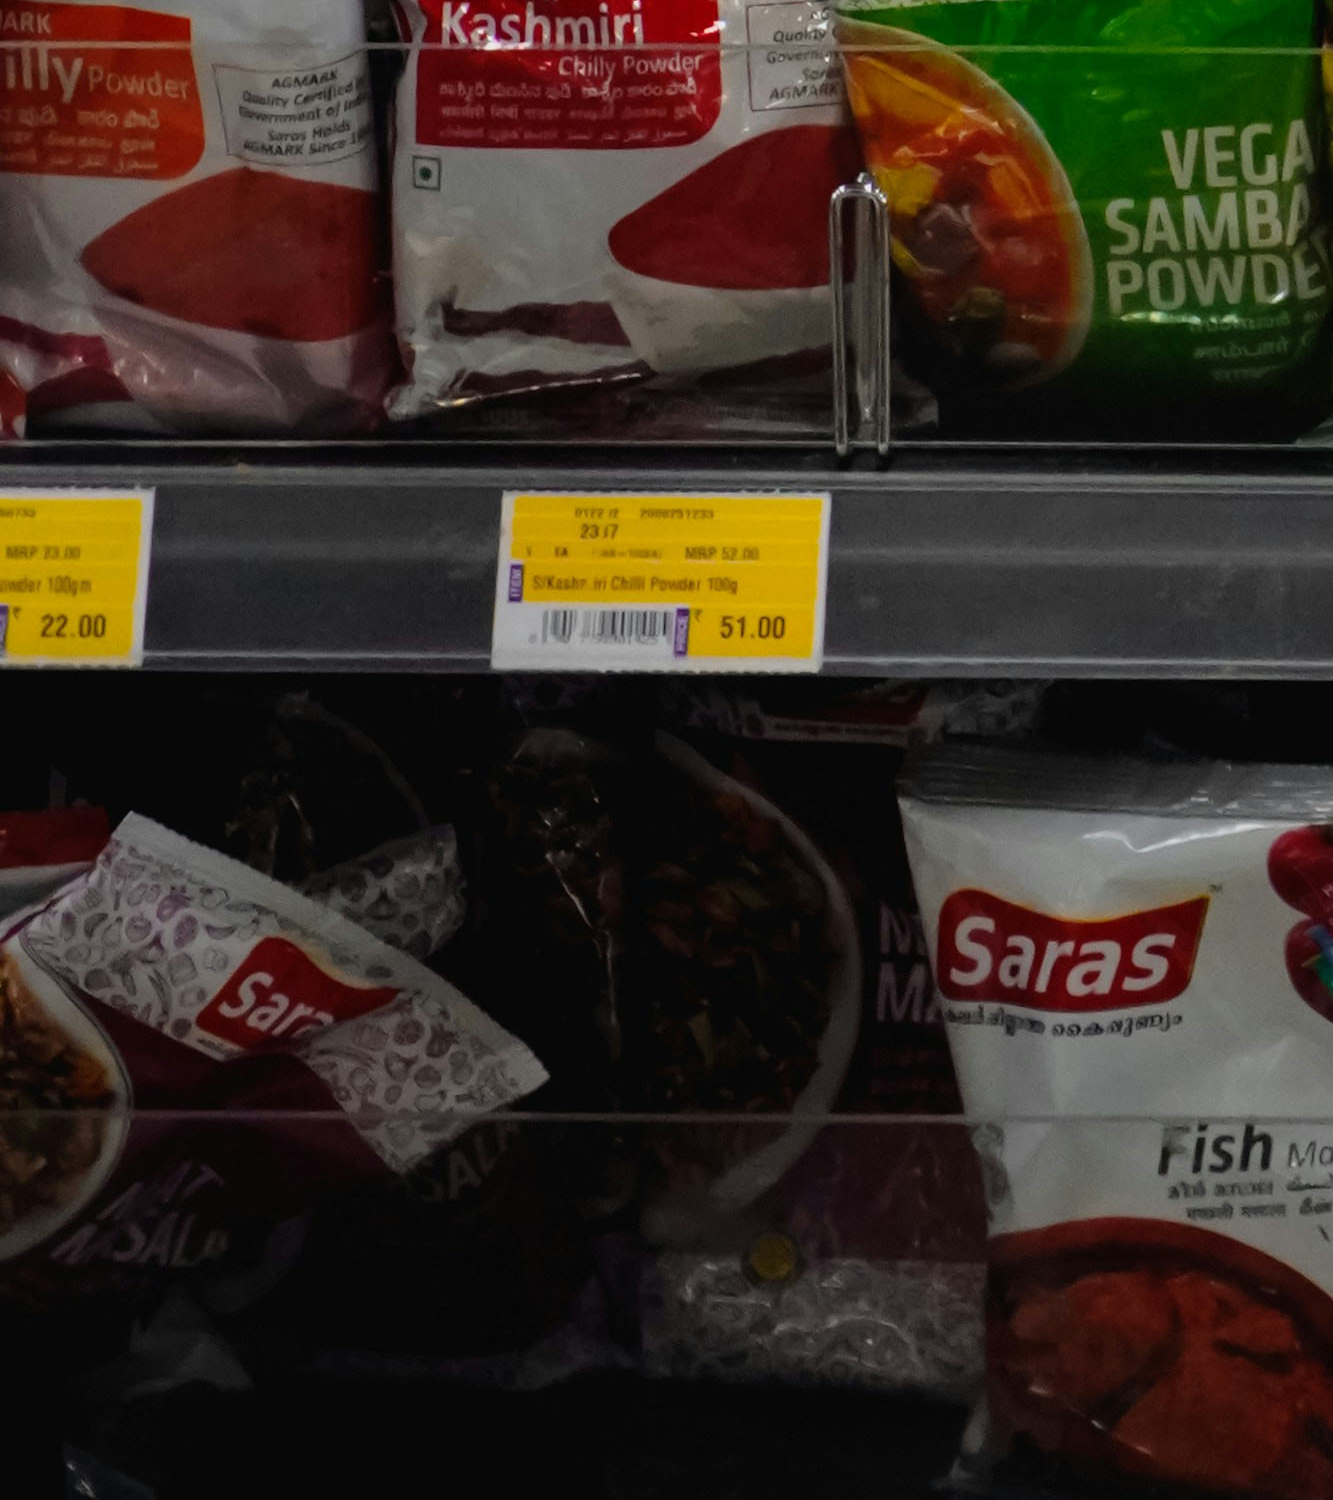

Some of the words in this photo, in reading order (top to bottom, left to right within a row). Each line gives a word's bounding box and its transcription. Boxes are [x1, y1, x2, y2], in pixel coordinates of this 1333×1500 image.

[441, 2, 643, 51] Kashmiri
[558, 52, 618, 77] Chilly
[622, 51, 703, 77] Powder
[41, 614, 106, 638] 22.00
[720, 615, 786, 639] 51.00
[948, 912, 1178, 998] Saras
[1156, 1124, 1272, 1175] Fish
